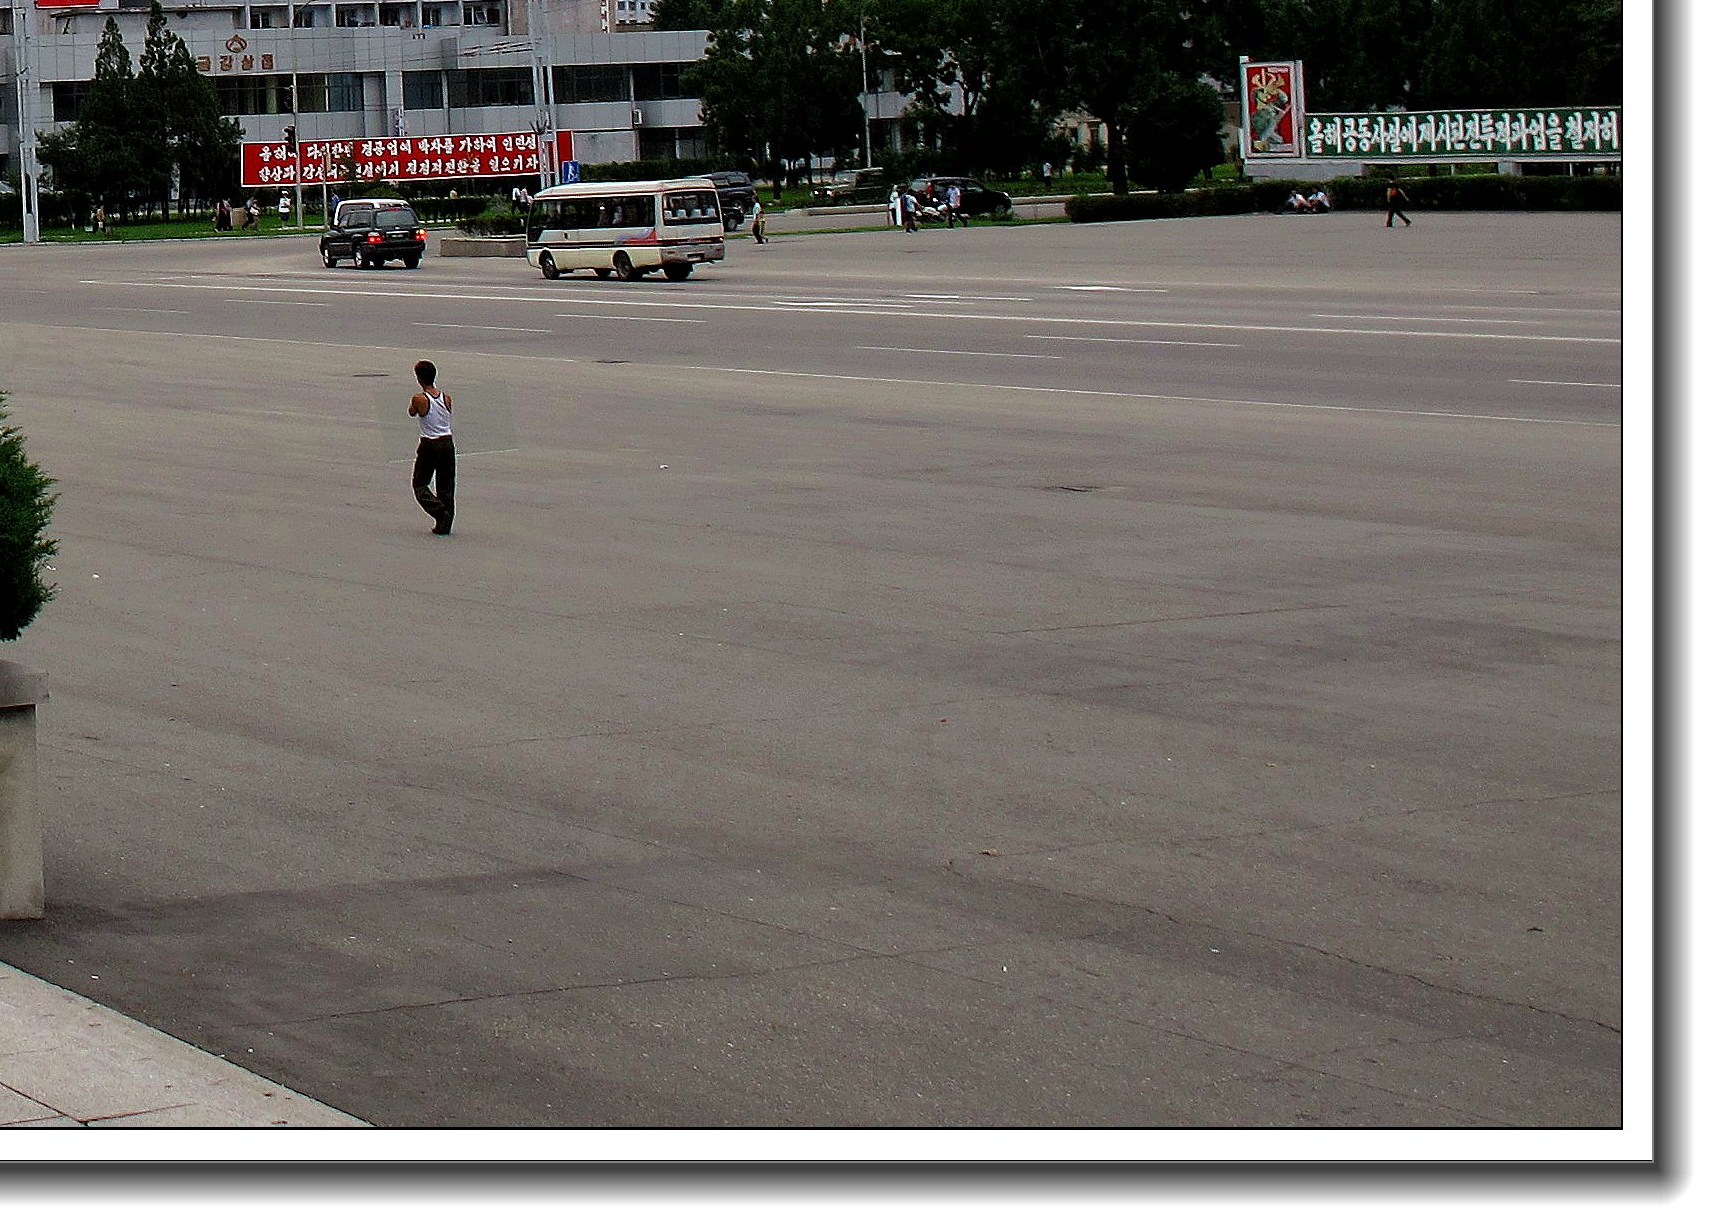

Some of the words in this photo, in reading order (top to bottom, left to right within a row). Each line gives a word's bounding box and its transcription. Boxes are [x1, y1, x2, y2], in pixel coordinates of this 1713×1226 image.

[259, 146, 297, 162] 올해
[361, 139, 412, 157] 경공업에
[418, 138, 455, 154] 박차를
